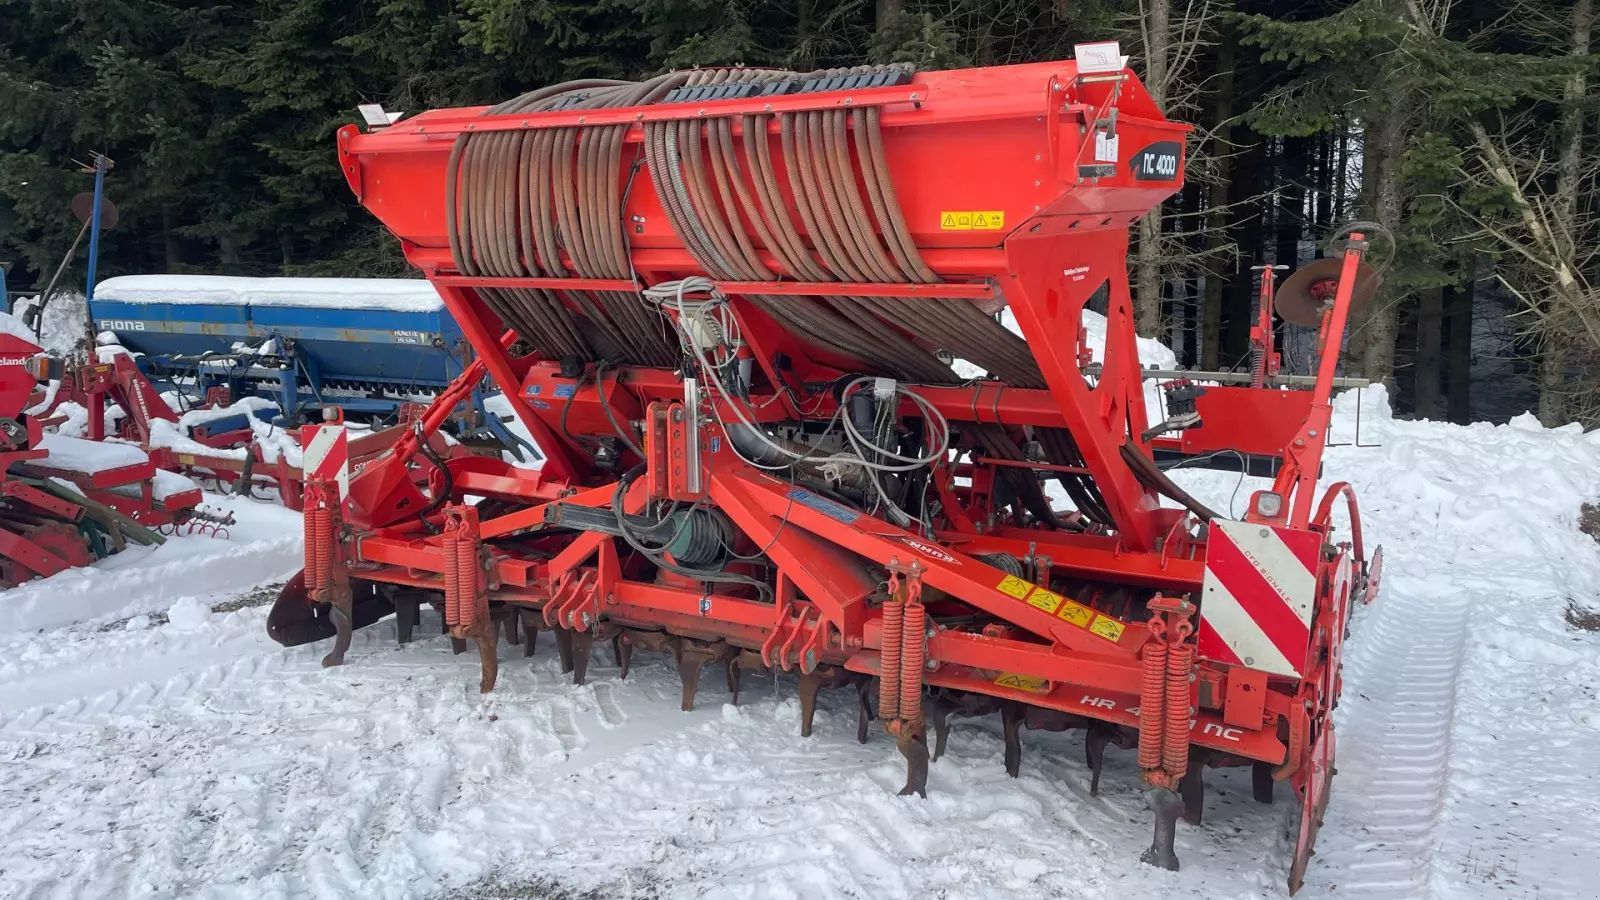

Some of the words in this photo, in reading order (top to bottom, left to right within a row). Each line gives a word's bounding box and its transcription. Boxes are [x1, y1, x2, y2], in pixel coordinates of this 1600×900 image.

[1156, 154, 1176, 175] 4000
[910, 541, 954, 562] KUHN
[1080, 695, 1117, 710] HR
